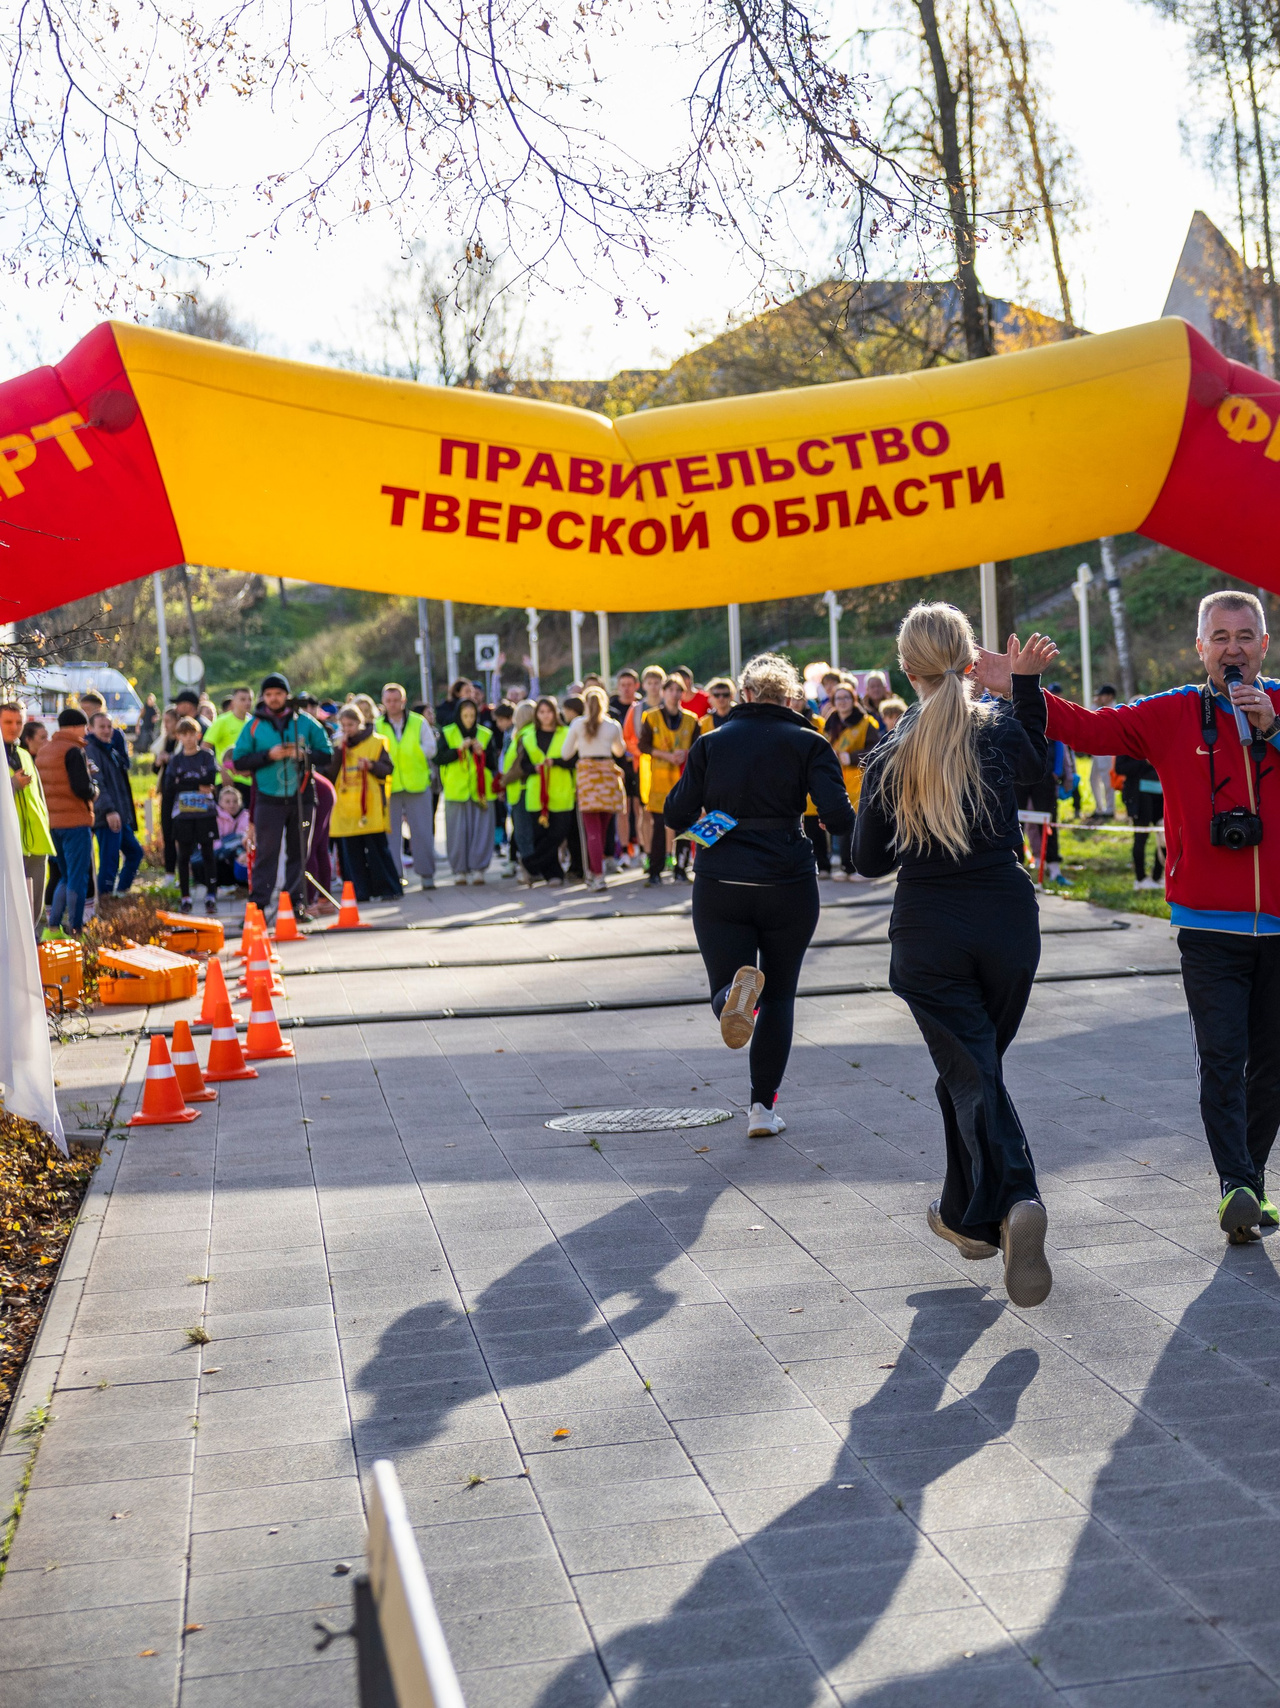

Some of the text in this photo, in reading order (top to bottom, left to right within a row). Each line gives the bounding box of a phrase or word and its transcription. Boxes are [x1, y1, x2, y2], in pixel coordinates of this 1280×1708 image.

[0, 411, 94, 500] РТ
[438, 420, 950, 502] ПРАВИТЕЛЬСТВО
[380, 462, 1005, 556] ТВЕРСКОЙ ОБЛАСТИ
